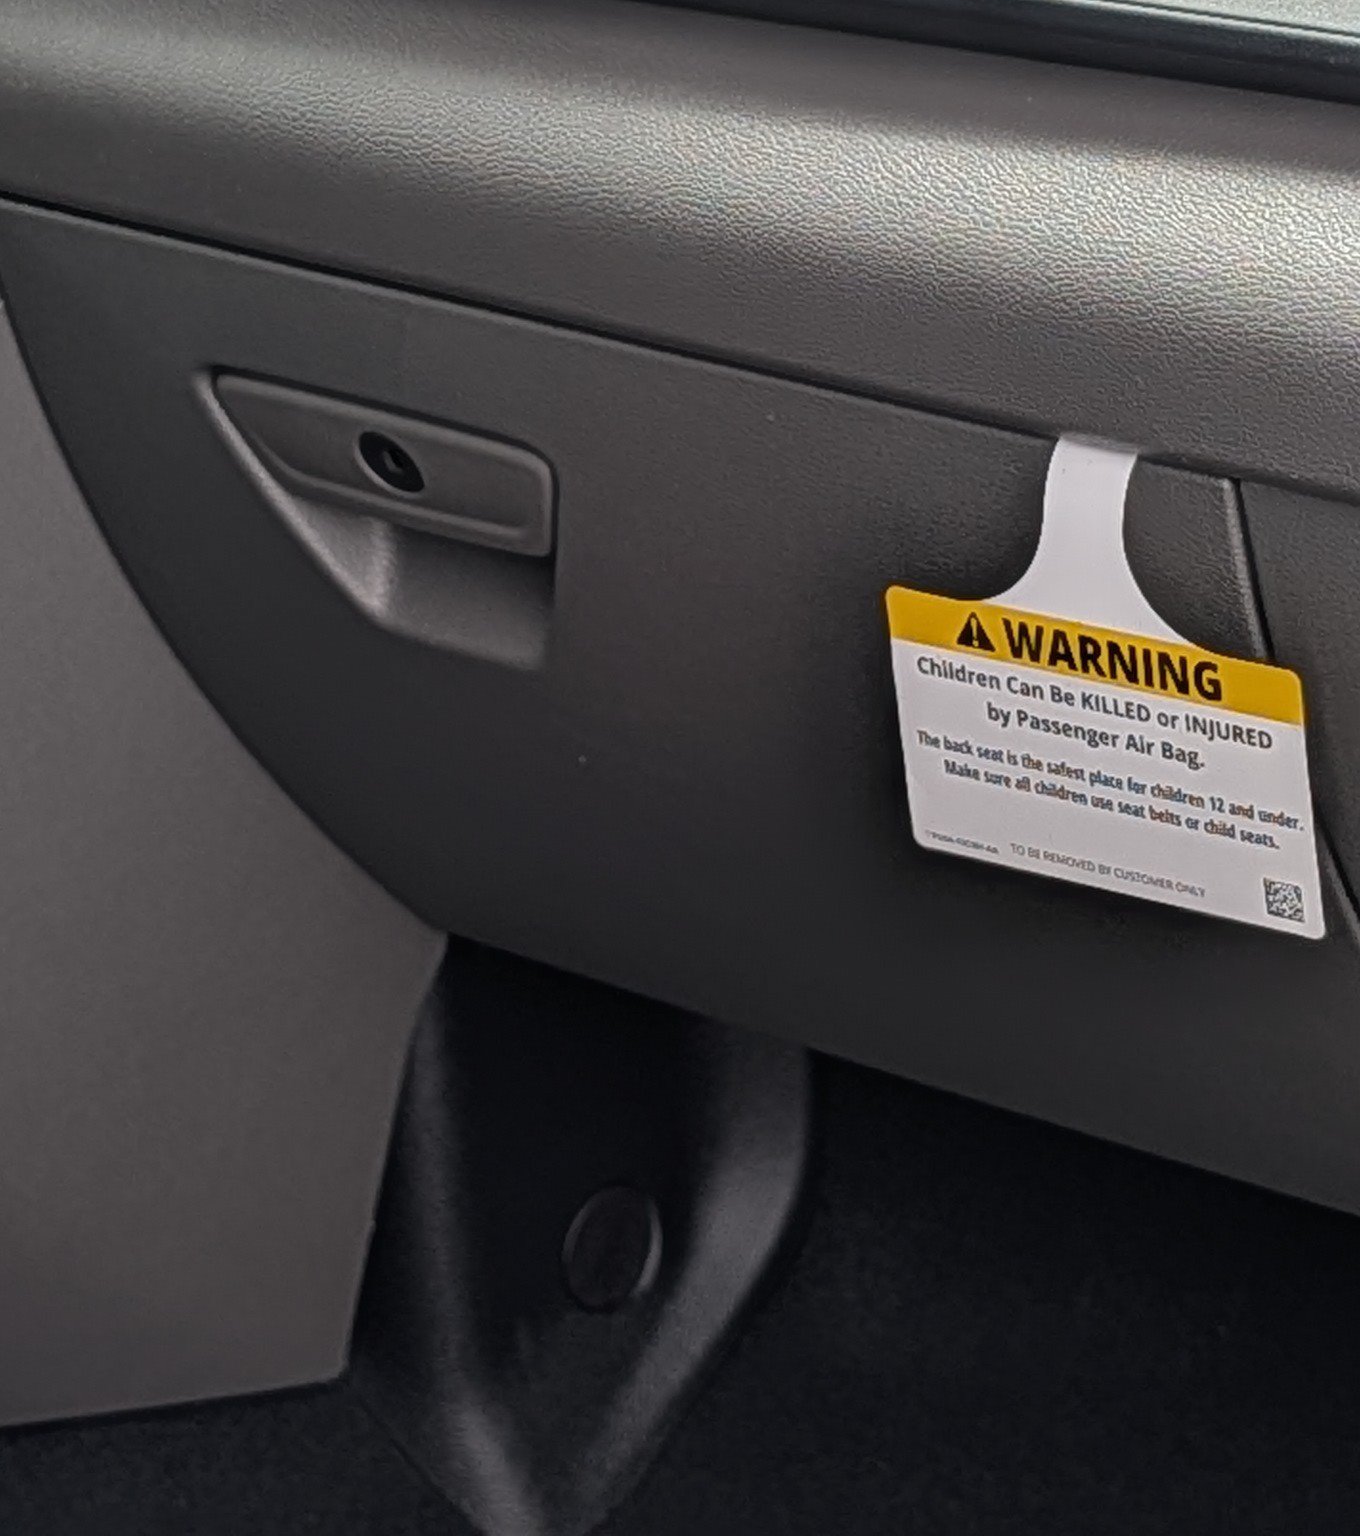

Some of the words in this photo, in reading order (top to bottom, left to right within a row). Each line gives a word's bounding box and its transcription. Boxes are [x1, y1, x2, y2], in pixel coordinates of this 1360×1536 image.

[916, 655, 1001, 691] Children
[1006, 675, 1045, 700] Can
[1049, 684, 1075, 707] Be
[1081, 691, 1151, 722] KILLED
[1157, 711, 1180, 730] or
[1185, 713, 1273, 750] INJURED
[1001, 617, 1223, 702] WARNING
[986, 700, 1012, 728] by
[1016, 709, 1120, 749] Passenger
[1125, 733, 1155, 756] Air
[1160, 741, 1206, 771] Bag.
[916, 730, 941, 749] The
[943, 735, 974, 756] back
[976, 745, 1004, 764] seat
[1006, 749, 1018, 766] is
[1021, 753, 1044, 772] the
[1047, 760, 1086, 782] safest
[1089, 769, 1123, 791] place
[1127, 776, 1147, 795] for
[1150, 783, 1205, 809] children
[1209, 795, 1226, 814] 12
[1229, 801, 1255, 820] and
[1257, 809, 1305, 832] under.
[943, 758, 981, 782] Make
[983, 771, 1012, 789] sure
[1014, 776, 1032, 793] all
[1034, 780, 1088, 806] children
[1090, 794, 1114, 812] use
[1117, 800, 1146, 819] seat
[1148, 805, 1182, 827] belts
[1185, 815, 1200, 830] or
[1204, 818, 1237, 839] child
[1239, 827, 1280, 849] seats.
[1010, 842, 1026, 856] TO
[1028, 846, 1041, 860] BE
[1043, 849, 1096, 873] REMOVED
[1098, 863, 1112, 876] BY
[1114, 867, 1174, 891] CUSTOMER
[1175, 881, 1206, 898] ONLY
